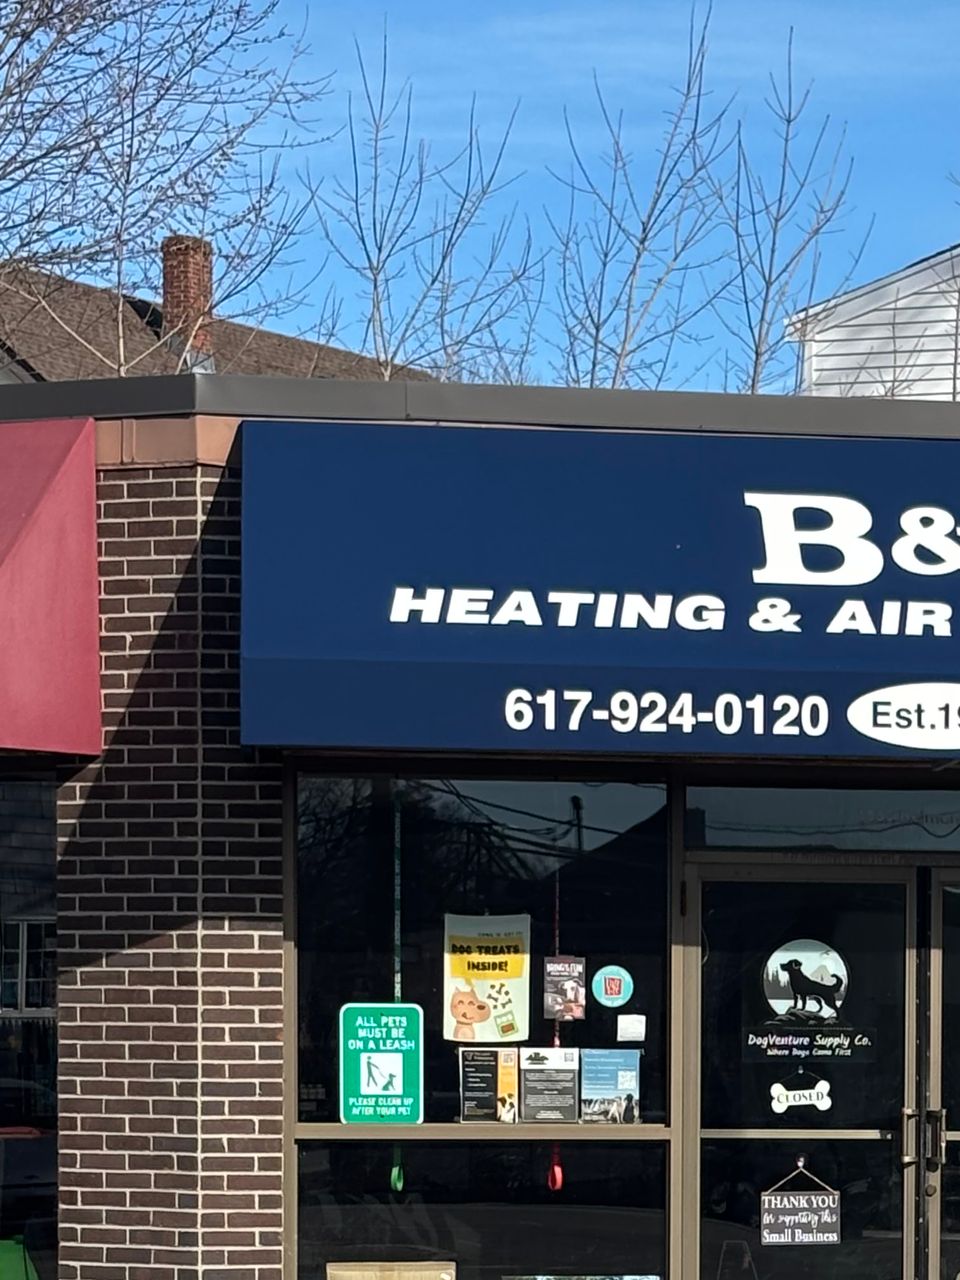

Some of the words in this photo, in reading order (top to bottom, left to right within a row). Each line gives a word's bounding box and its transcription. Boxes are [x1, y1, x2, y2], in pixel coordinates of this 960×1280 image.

[388, 587, 726, 632] HEATING
[749, 598, 802, 634] &
[826, 600, 953, 638] AIR
[504, 688, 829, 737] 617-924-0120
[451, 944, 473, 954] DOG
[476, 944, 520, 955] TREATS
[467, 960, 508, 972] INSIDE!
[355, 1016, 377, 1027] ALL
[381, 1016, 407, 1027] PETS
[358, 1028, 387, 1038] MUST
[391, 1028, 405, 1038] BE
[348, 1040, 363, 1050] ON
[368, 1040, 376, 1050] A
[380, 1040, 415, 1050] LEASH
[747, 1034, 810, 1048] DogVenture
[813, 1033, 850, 1048] Supply
[854, 1034, 872, 1046] Co.
[792, 1048, 810, 1058] Dogs
[834, 1048, 852, 1056] First
[349, 1097, 376, 1106] PLEASE
[378, 1097, 402, 1106] CLEAN
[403, 1097, 414, 1106] UP
[776, 1091, 824, 1104] CLOSED
[352, 1107, 374, 1115] AFTER
[376, 1107, 396, 1115] YOUR
[397, 1107, 411, 1115] PET
[761, 1196, 809, 1209] THANK
[811, 1196, 838, 1209] YOU
[762, 1229, 792, 1242] Small
[794, 1229, 838, 1242] Business
